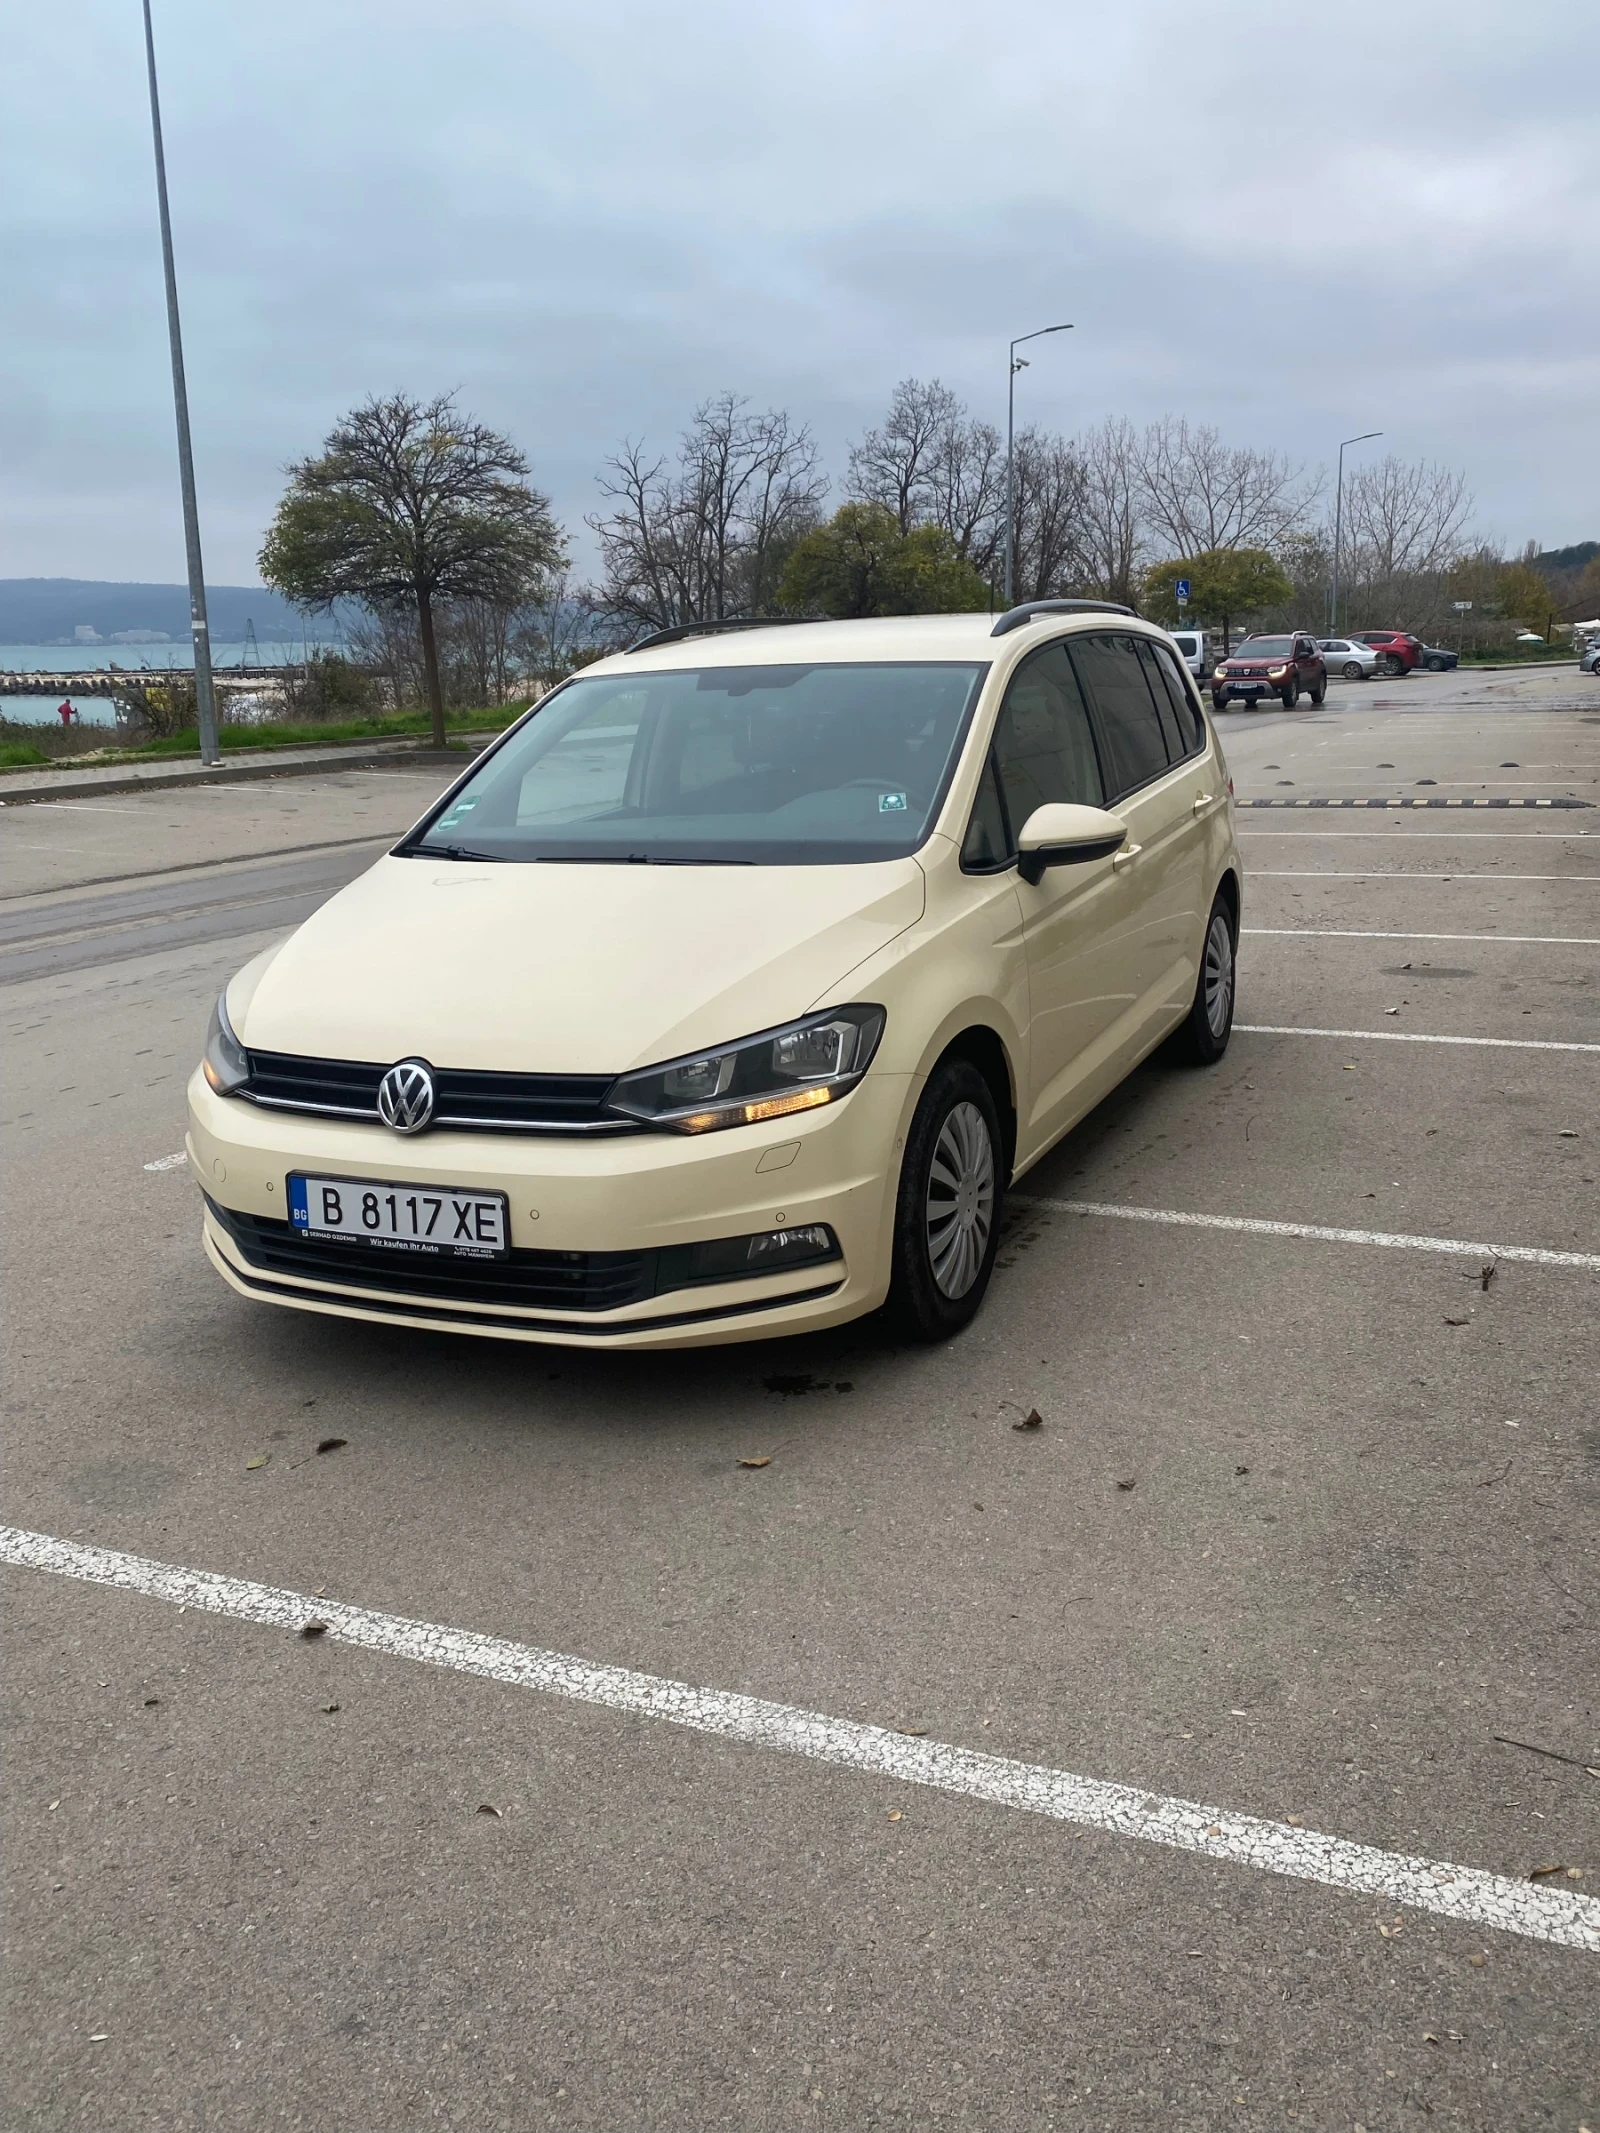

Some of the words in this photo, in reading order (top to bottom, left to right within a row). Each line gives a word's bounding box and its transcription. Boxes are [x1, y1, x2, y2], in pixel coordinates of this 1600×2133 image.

[322, 1187, 343, 1225] B
[293, 1208, 308, 1221] BG
[369, 1237, 383, 1246] Wir
[383, 1239, 409, 1249] kaufen
[409, 1241, 421, 1250] Ihr
[421, 1243, 439, 1252] Auto
